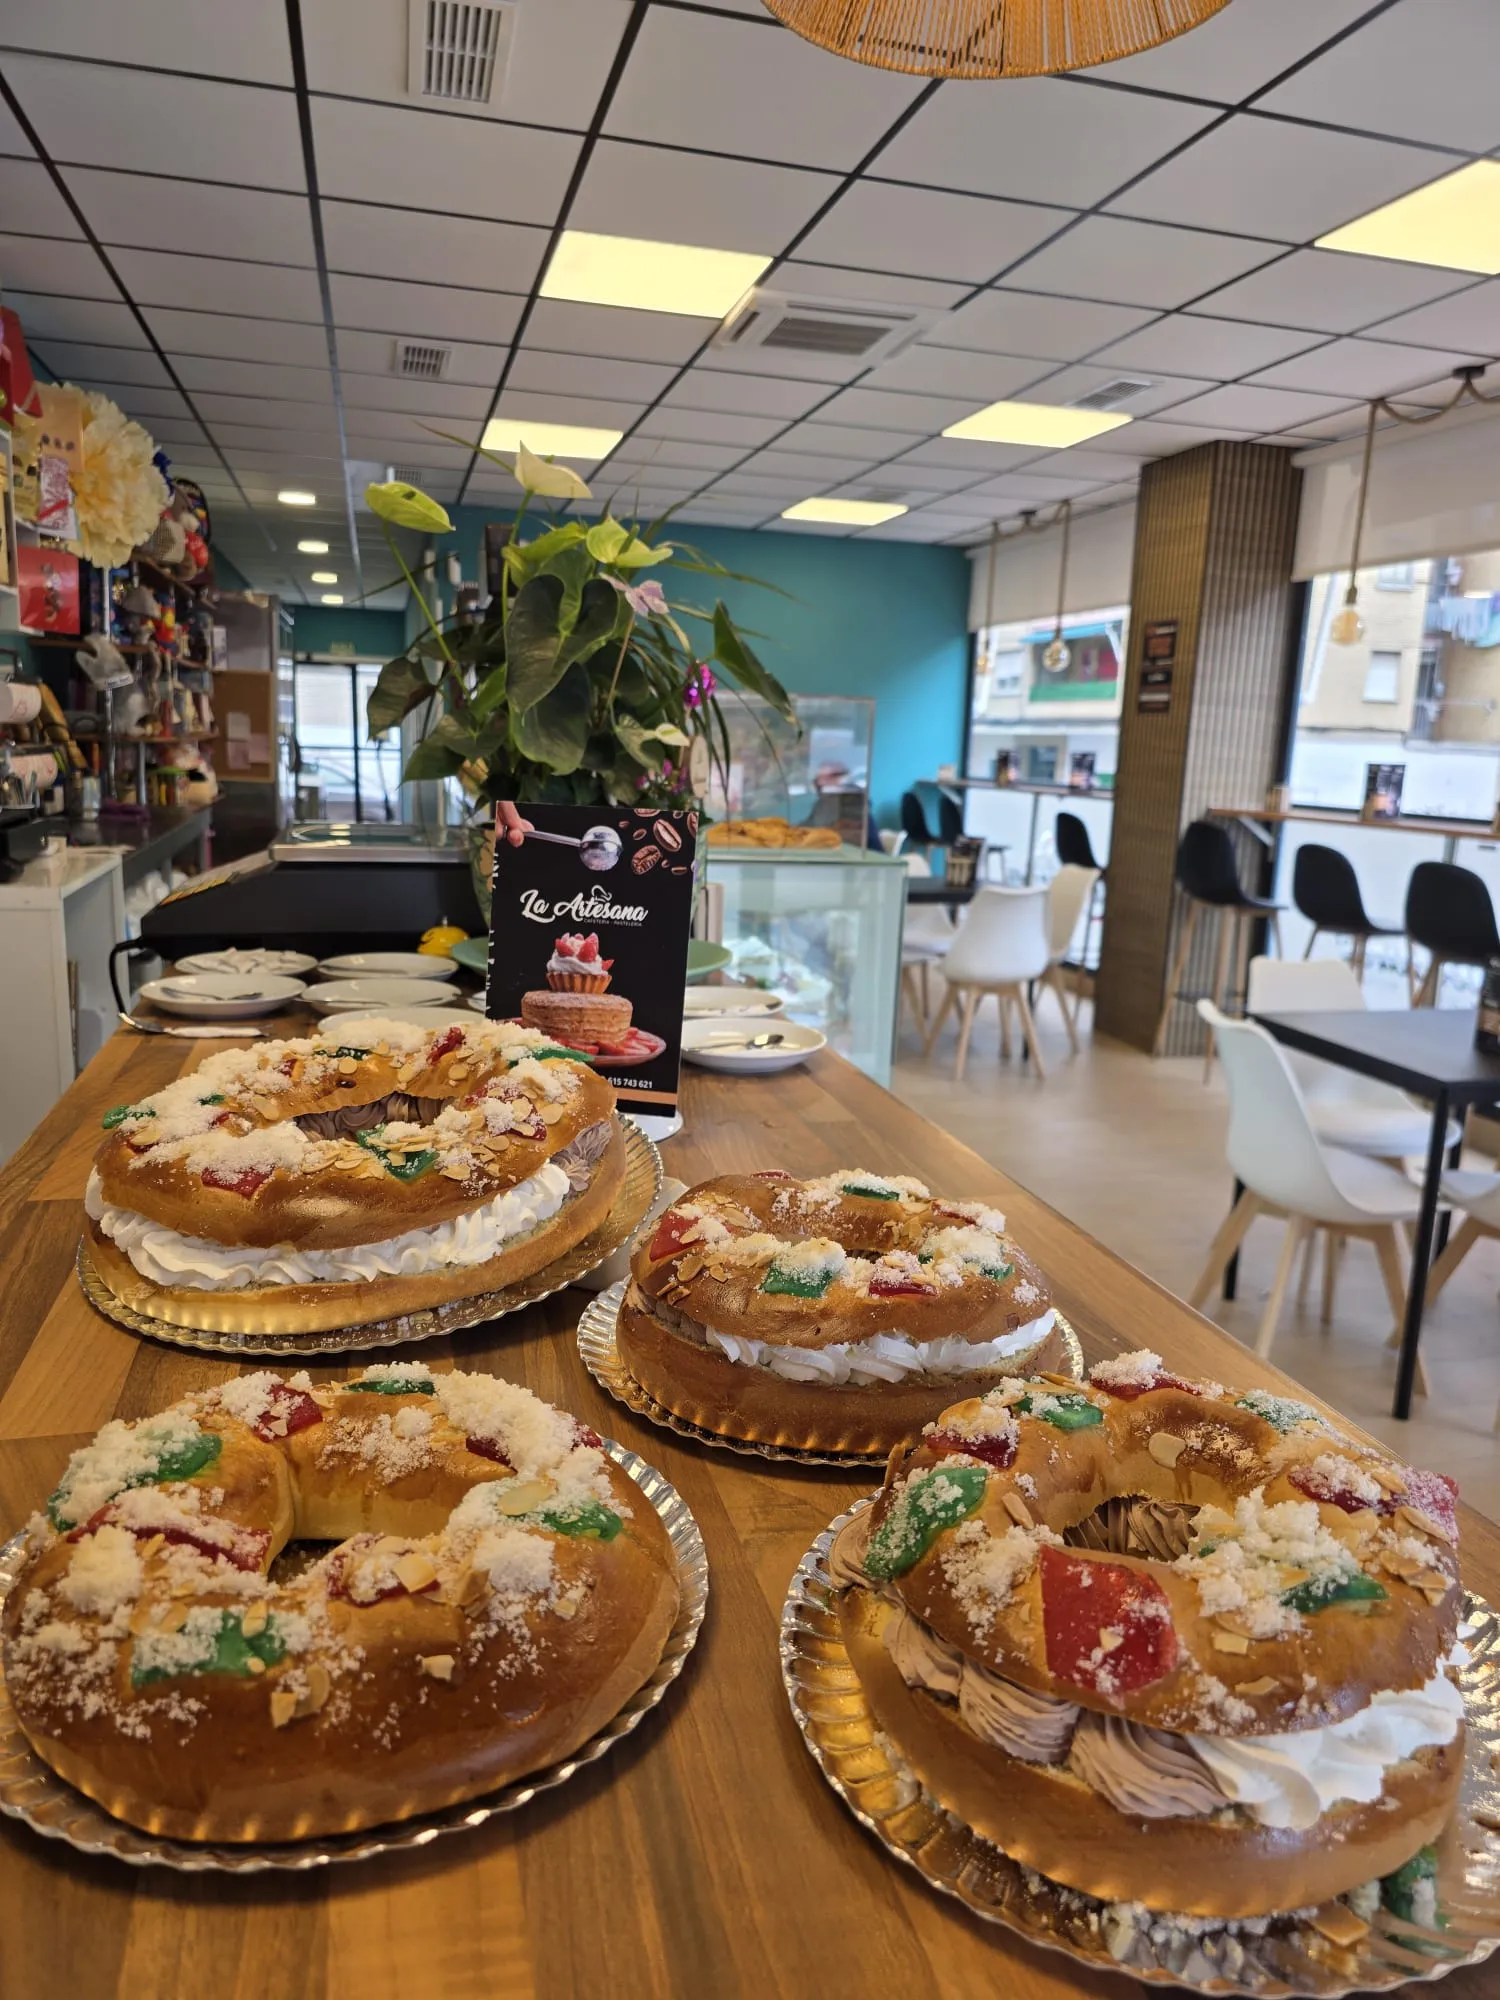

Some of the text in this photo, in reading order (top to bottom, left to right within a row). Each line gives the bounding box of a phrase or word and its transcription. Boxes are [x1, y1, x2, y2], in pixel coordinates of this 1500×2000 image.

[519, 889, 649, 923] La Artesana
[623, 1077, 638, 1088] 743
[638, 1079, 653, 1089] 621
